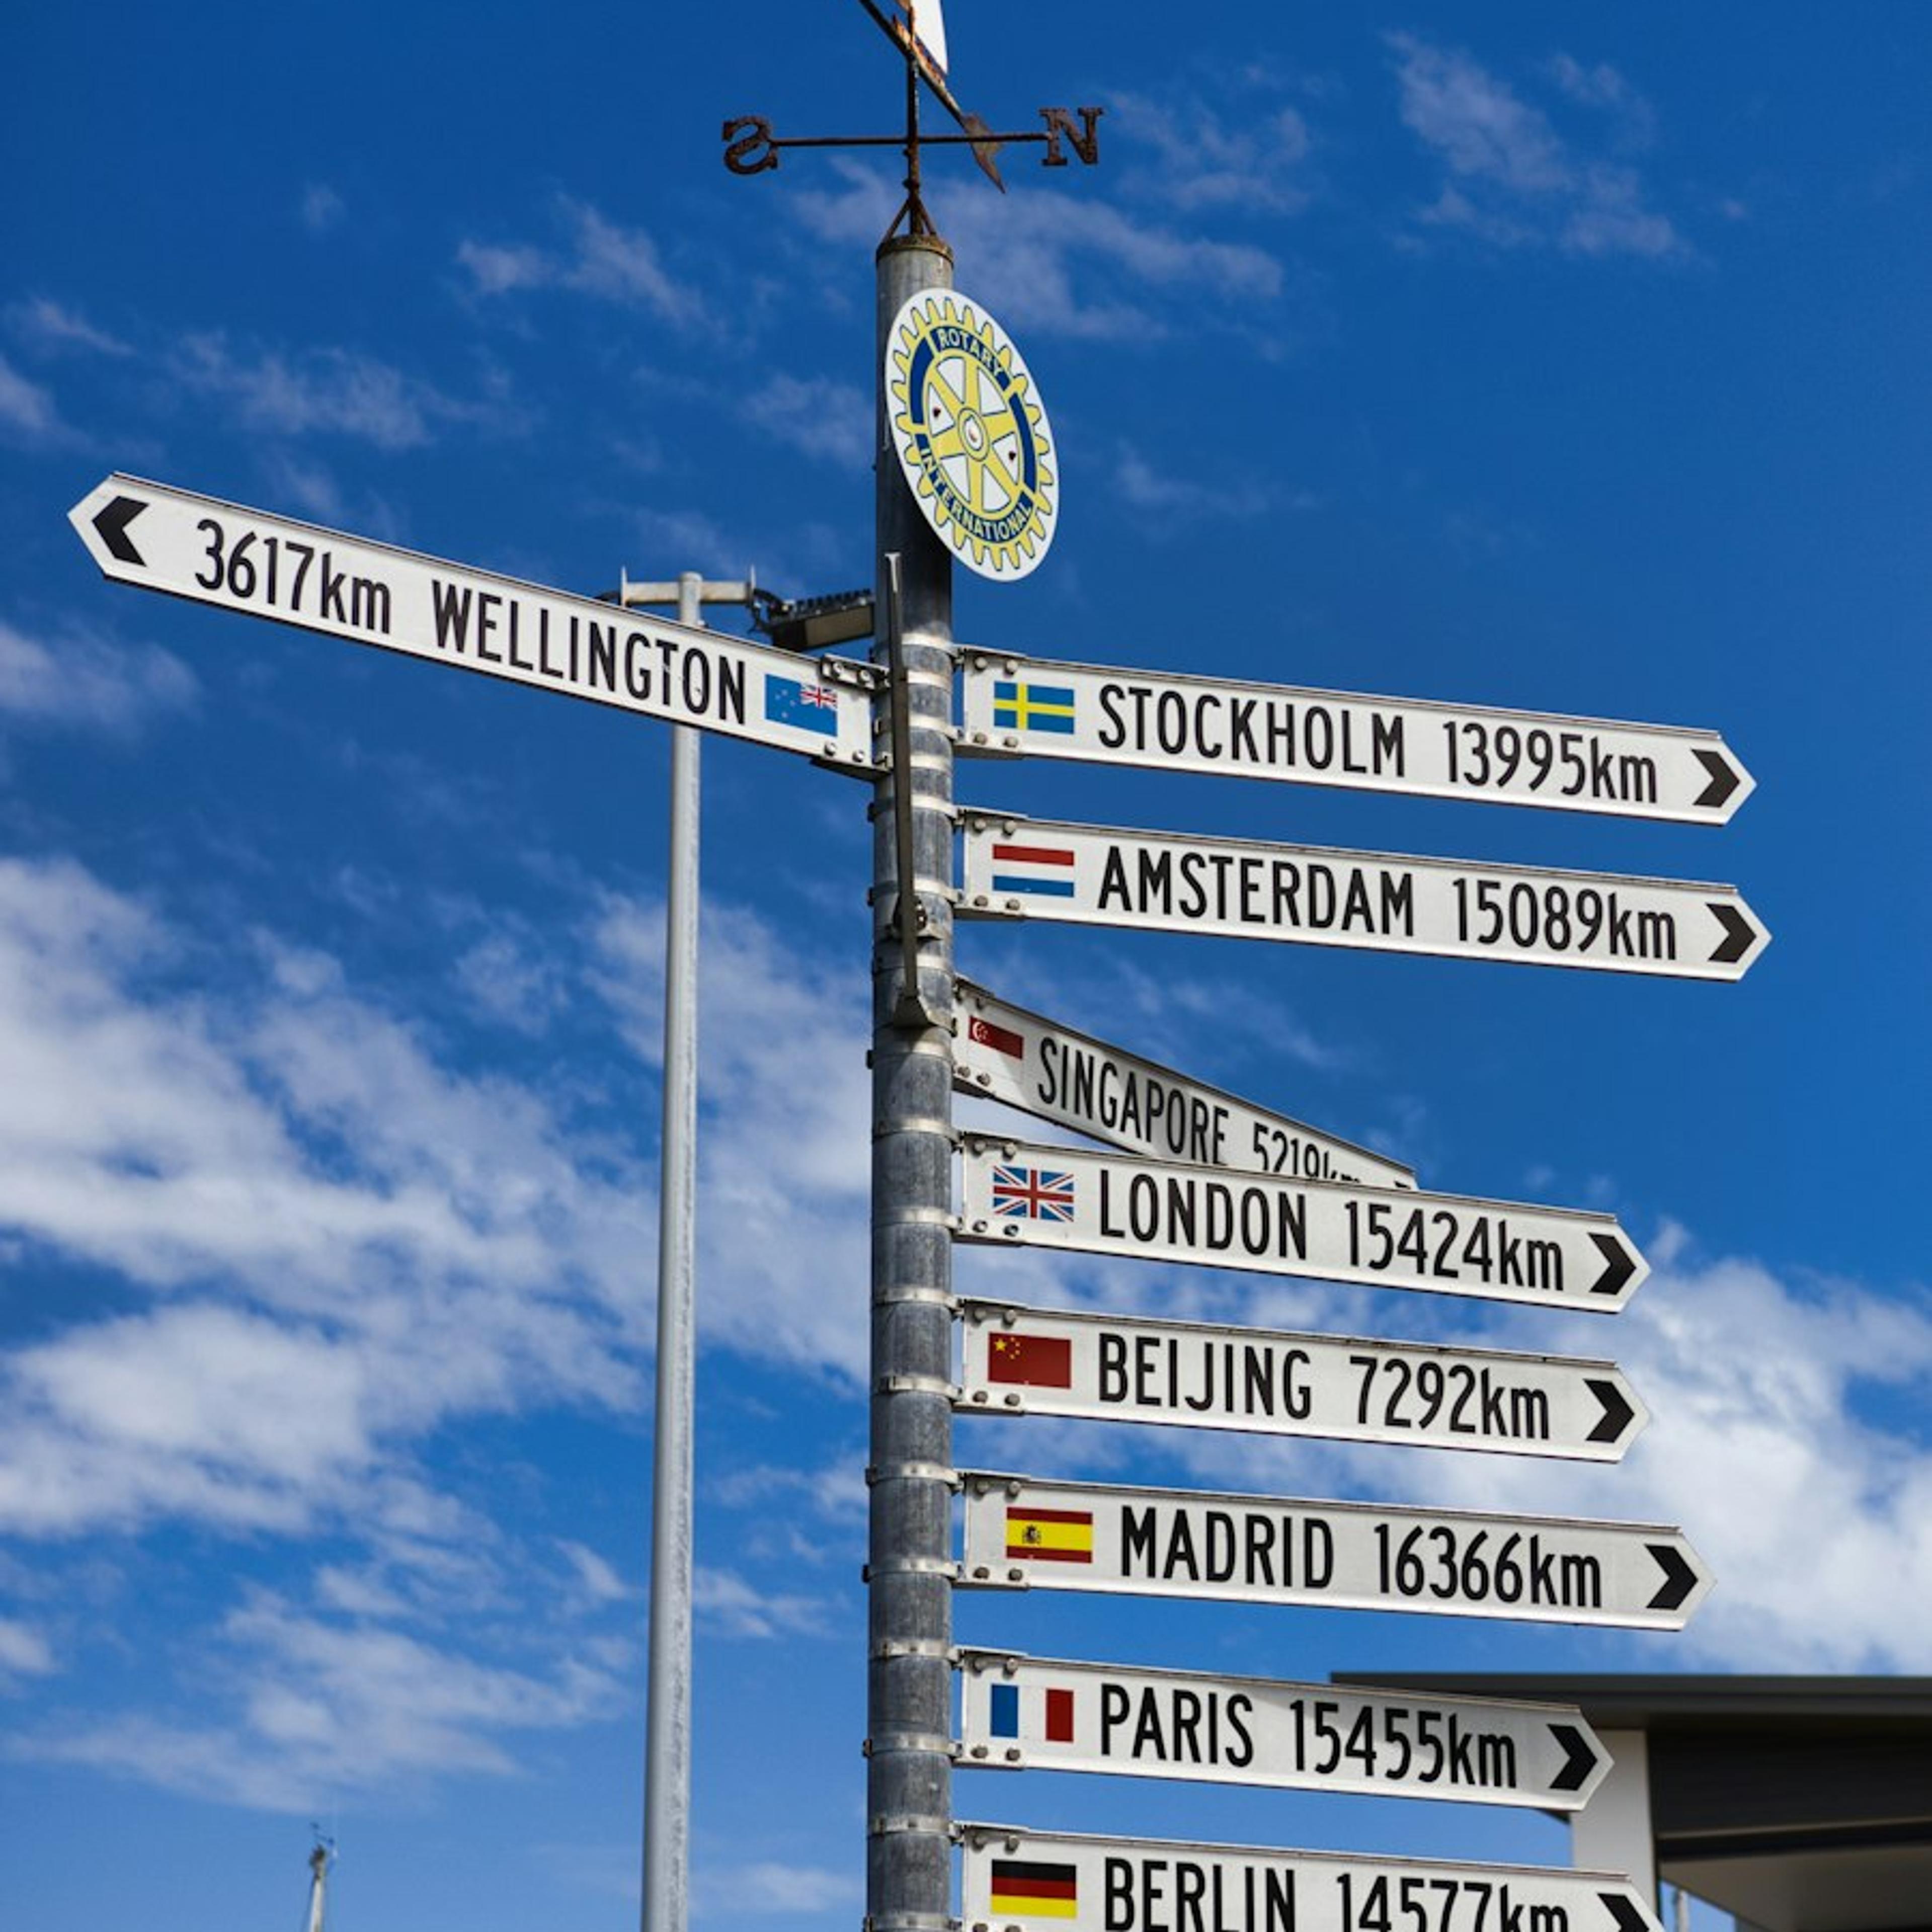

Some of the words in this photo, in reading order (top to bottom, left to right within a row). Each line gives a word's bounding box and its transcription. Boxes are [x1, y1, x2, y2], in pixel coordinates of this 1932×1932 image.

[1039, 107, 1103, 166] N
[937, 328, 1006, 379] ROTARY
[920, 447, 1034, 542] INTERNATIONAL
[195, 519, 391, 634] 3617km
[432, 579, 745, 725] WELLINGTON
[1098, 684, 1404, 777] STOCKHOLM
[1443, 721, 1656, 803] 13995km
[1097, 846, 1413, 937] AMSTERDAM
[1453, 878, 1676, 960] 15089km
[1037, 1036, 1229, 1166] SINGAPORE
[1253, 1121, 1361, 1183] 5219
[1100, 1169, 1307, 1260] LONDON
[1345, 1201, 1564, 1296] 15424km
[1099, 1333, 1311, 1420] BEIJING
[1349, 1355, 1549, 1440] 7292km
[1121, 1505, 1334, 1589] MADRID
[1374, 1523, 1601, 1608] 16366km
[1101, 1683, 1253, 1767] PARIS
[1289, 1699, 1517, 1789] 15455km
[1105, 1857, 1296, 1932] BERLIN
